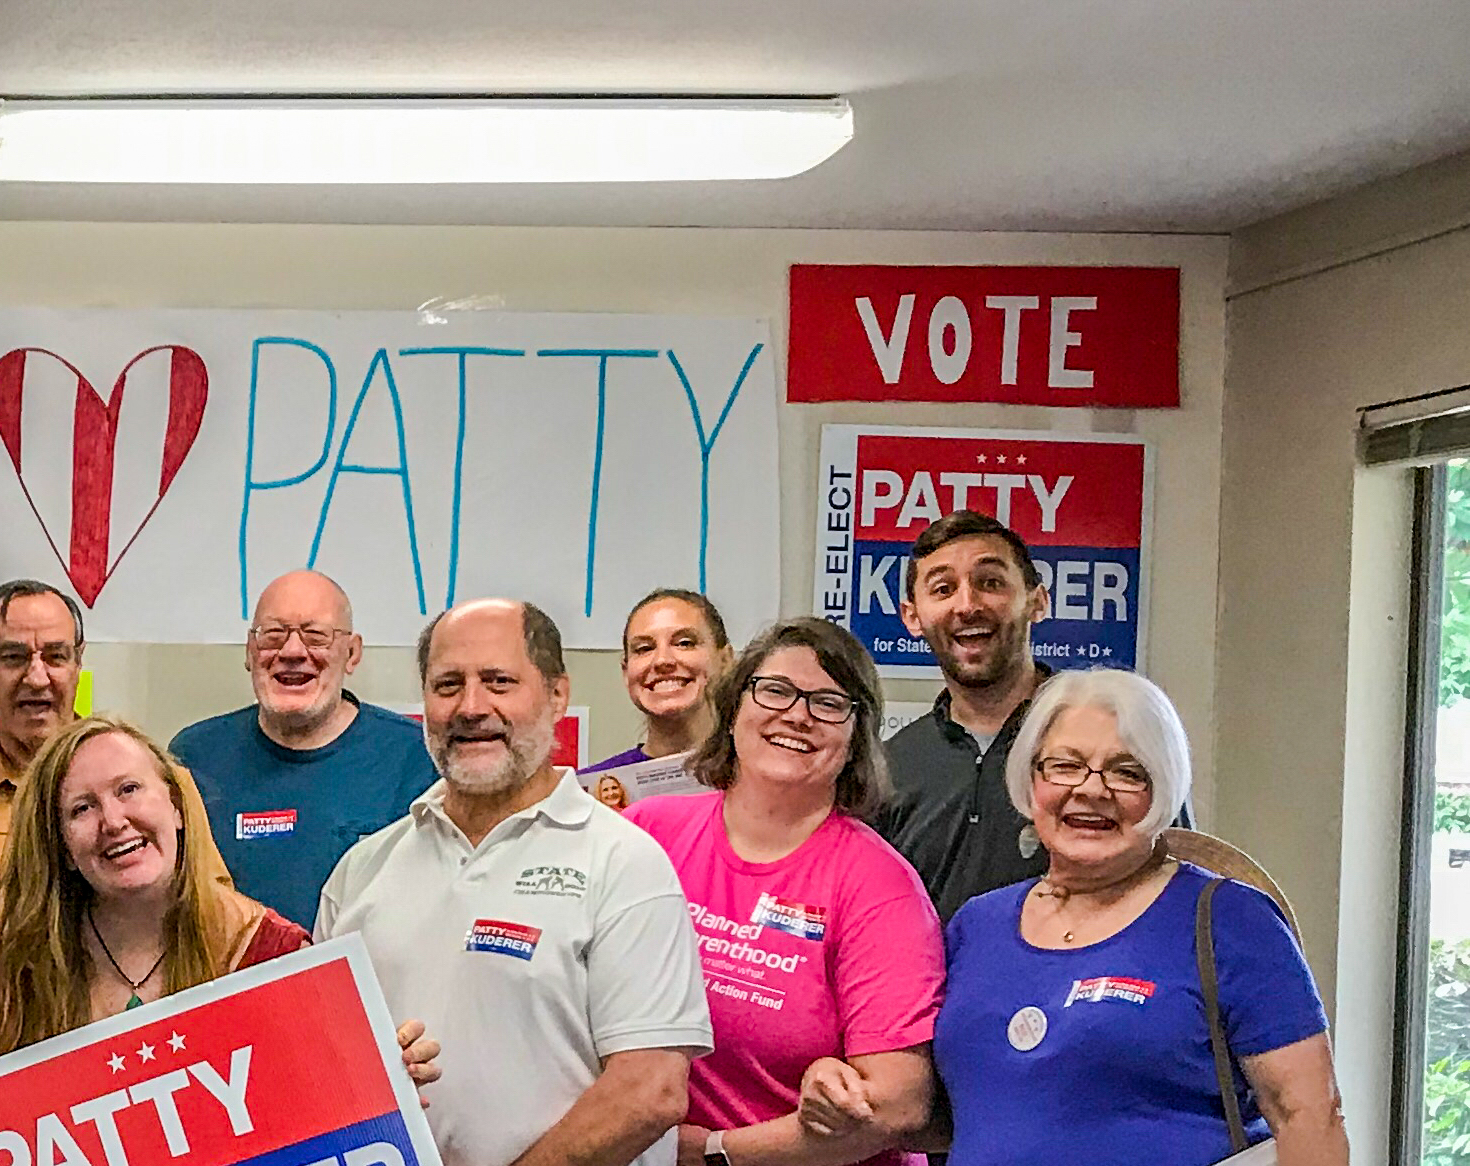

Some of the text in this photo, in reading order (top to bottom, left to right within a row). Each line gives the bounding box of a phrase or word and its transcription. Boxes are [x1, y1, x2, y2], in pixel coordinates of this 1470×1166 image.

[855, 294, 1098, 389] VOTE
[240, 335, 765, 621] PATTY
[860, 469, 1075, 533] PATTY
[874, 637, 893, 652] for
[1030, 641, 1101, 658] istrict D
[243, 822, 294, 834] KUDERER
[520, 866, 587, 886] STATE
[473, 925, 507, 936] PATTY
[761, 910, 825, 934] KUDERER
[469, 934, 532, 953] KUDERER
[710, 980, 748, 1001] Action
[749, 991, 784, 1011] Fund
